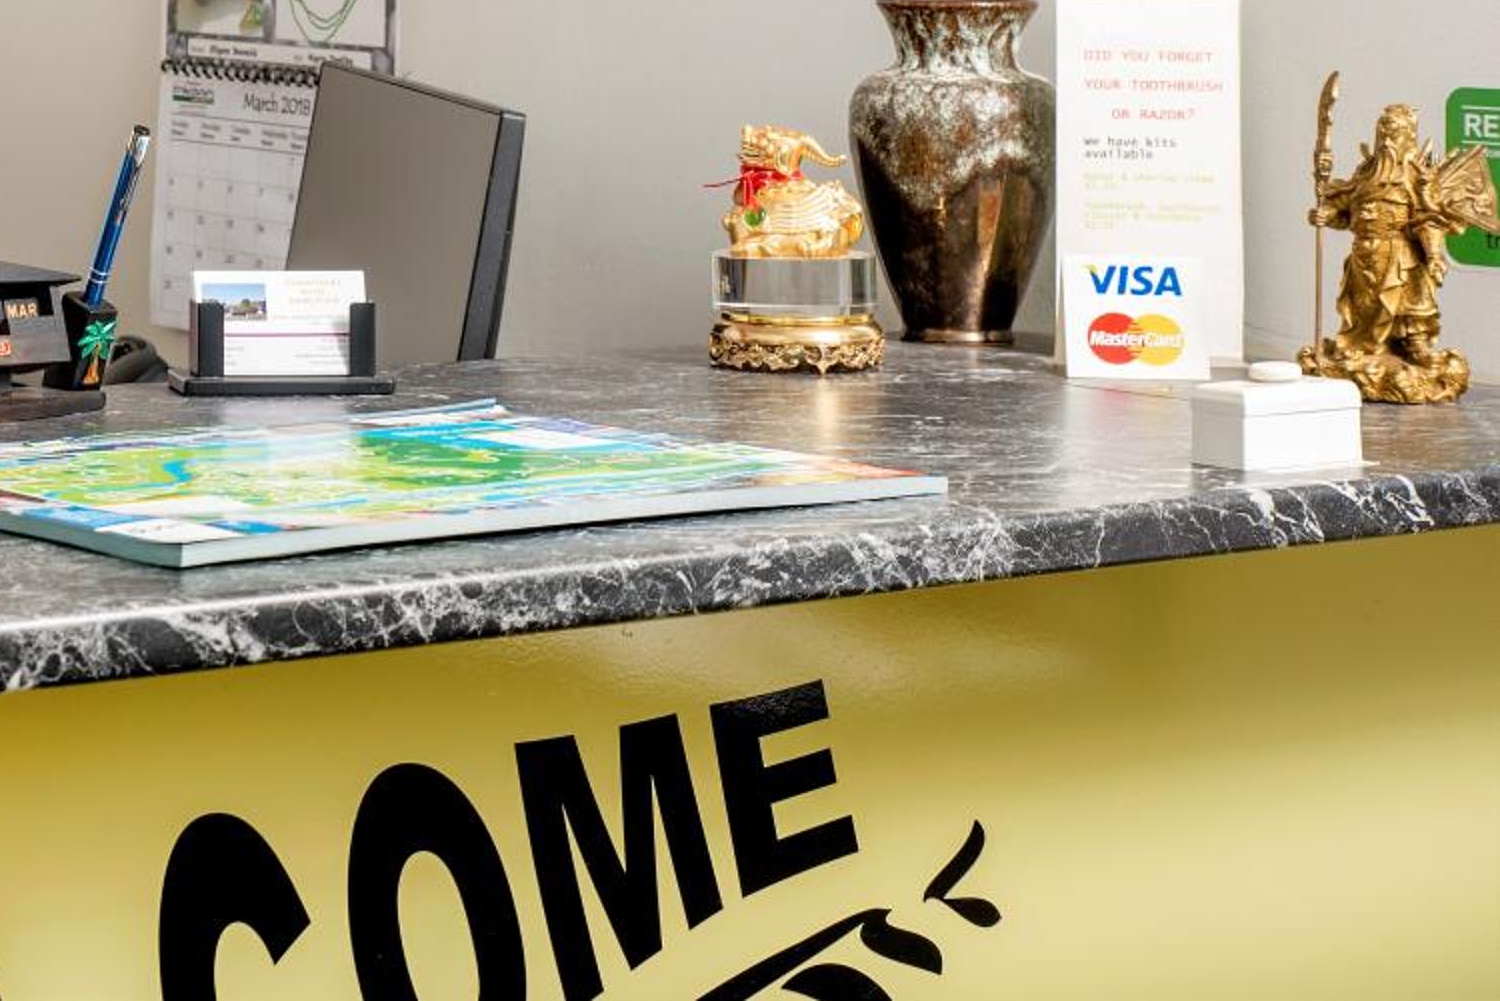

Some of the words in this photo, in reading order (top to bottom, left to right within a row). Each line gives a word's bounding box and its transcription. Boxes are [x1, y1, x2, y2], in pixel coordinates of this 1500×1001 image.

[1084, 49, 1111, 62] DID
[1122, 50, 1149, 62] YOU
[1157, 50, 1213, 63] FORGET
[1084, 78, 1121, 90] YOUR
[1130, 79, 1223, 92] TOOTHBRUSH
[243, 91, 278, 112] March
[281, 95, 311, 116] 2018
[1111, 108, 1130, 119] OR
[1108, 135, 1138, 148] have
[1145, 137, 1177, 149] kits
[1084, 149, 1153, 161] available
[1084, 264, 1183, 296] VISA
[6, 302, 37, 319] MAR
[1091, 329, 1184, 348] MasterCard
